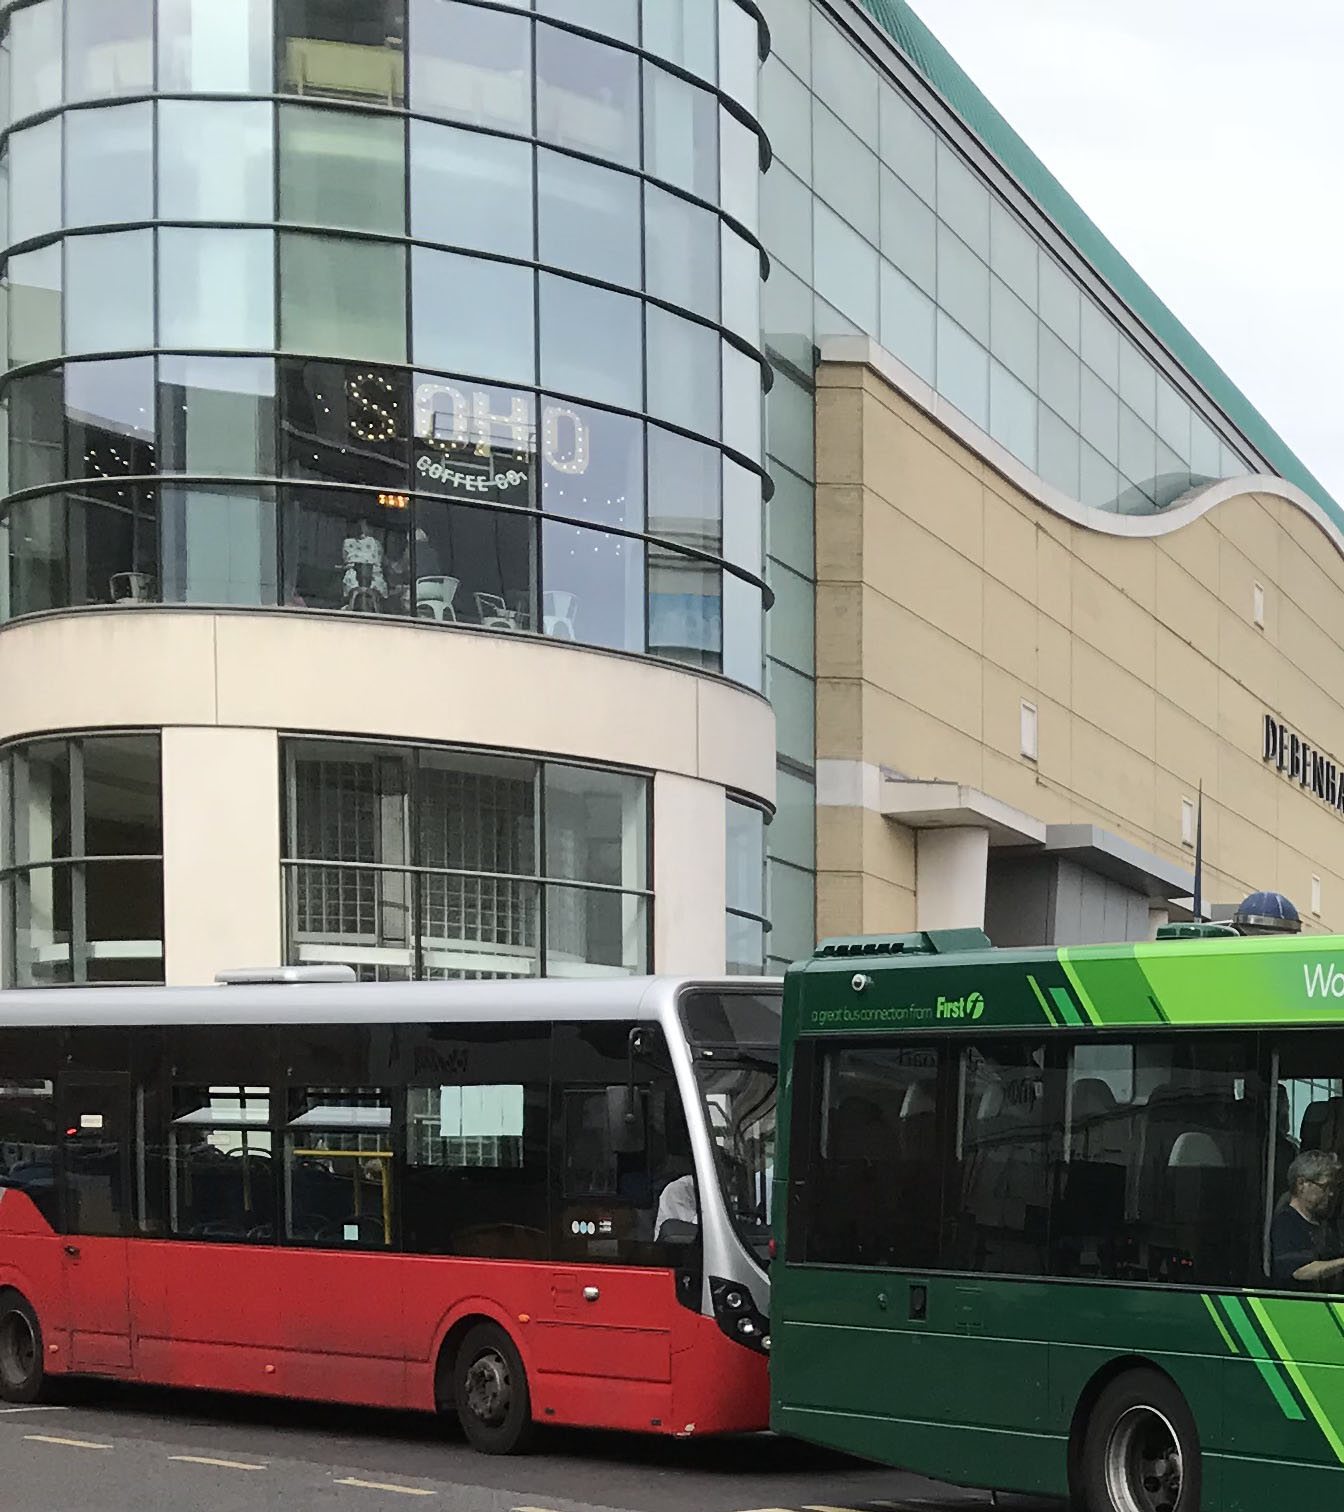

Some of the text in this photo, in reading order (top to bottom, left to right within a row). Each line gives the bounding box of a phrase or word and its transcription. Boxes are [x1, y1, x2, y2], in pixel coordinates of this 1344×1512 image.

[346, 373, 589, 474] SOHO
[416, 455, 489, 492] COFFEE
[937, 996, 965, 1018] First
